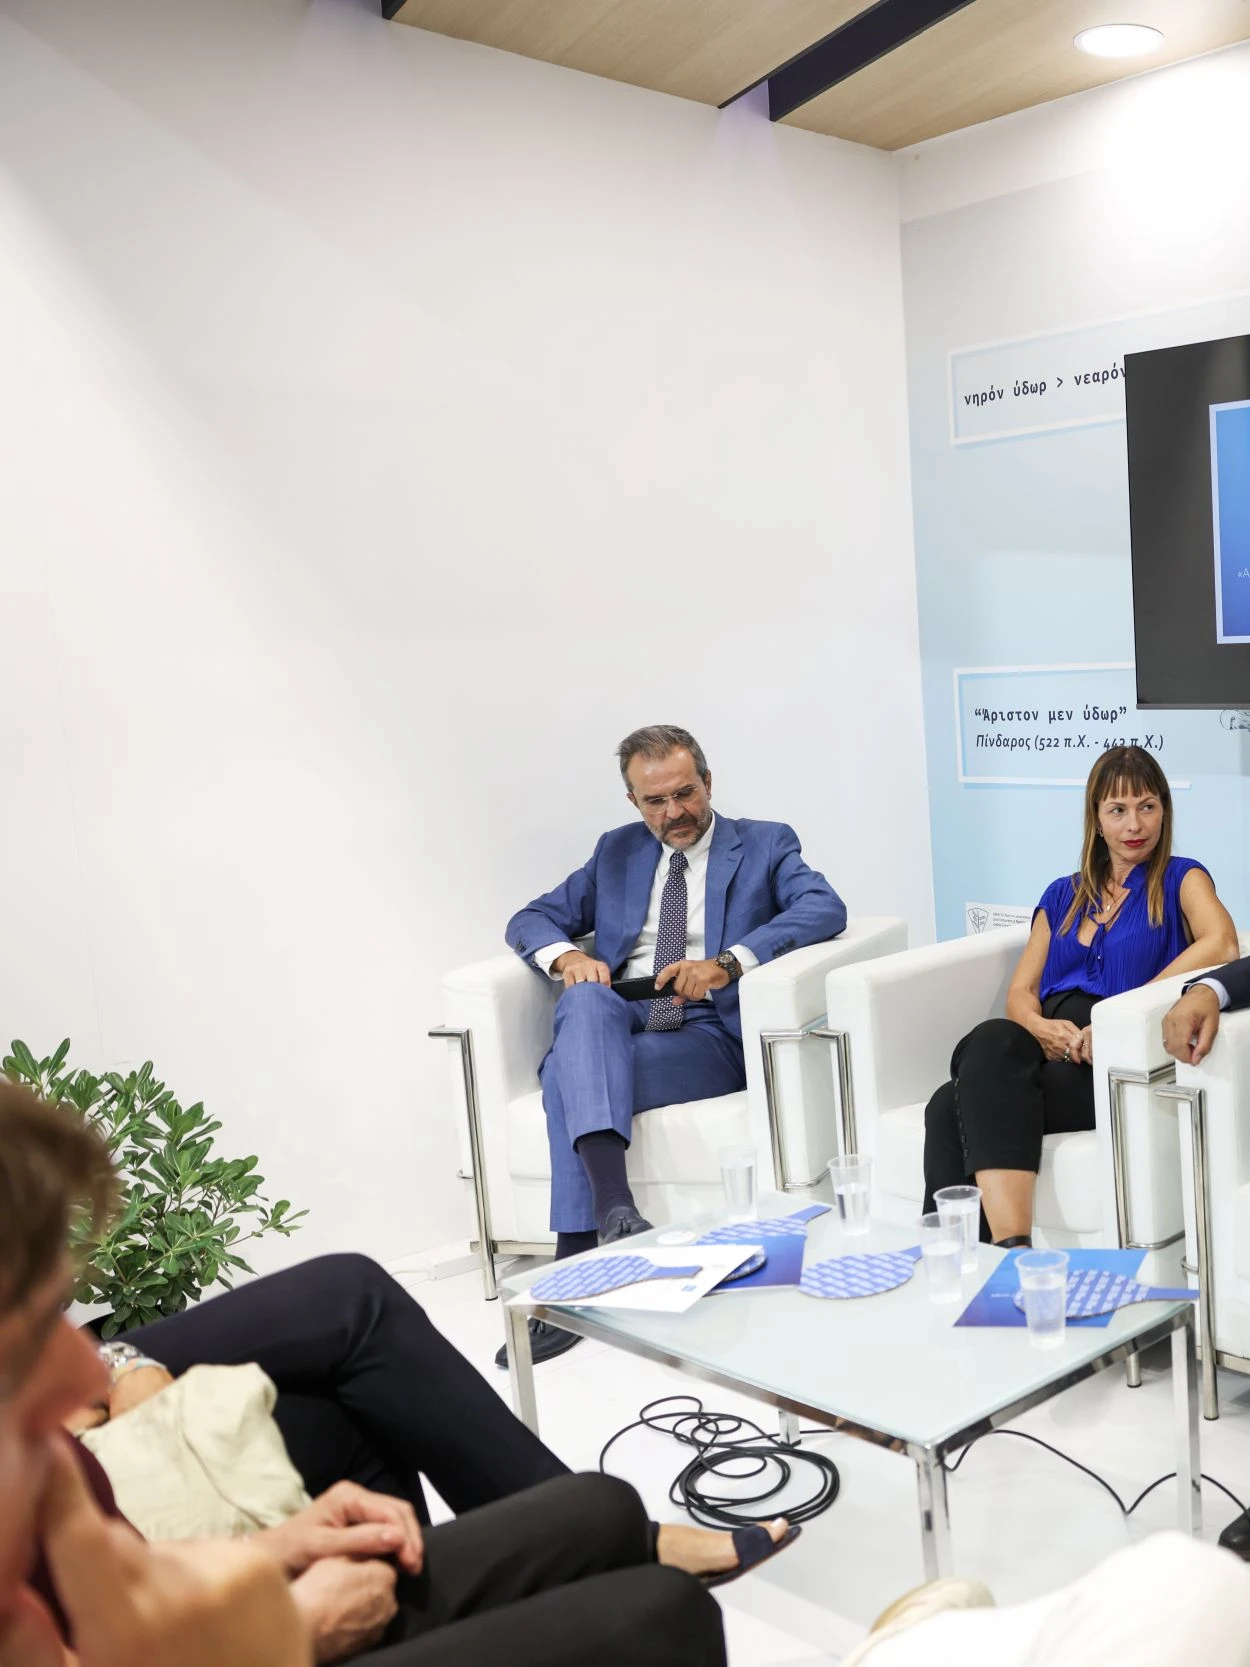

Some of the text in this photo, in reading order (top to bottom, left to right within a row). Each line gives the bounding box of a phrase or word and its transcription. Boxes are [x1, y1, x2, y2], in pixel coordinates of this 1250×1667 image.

[964, 385, 1004, 407] νηρόν
[1013, 380, 1047, 399] ύδωρ
[1049, 710, 1073, 724] μεν
[976, 734, 1031, 751] Πίνδαρος
[1034, 735, 1060, 751] (522
